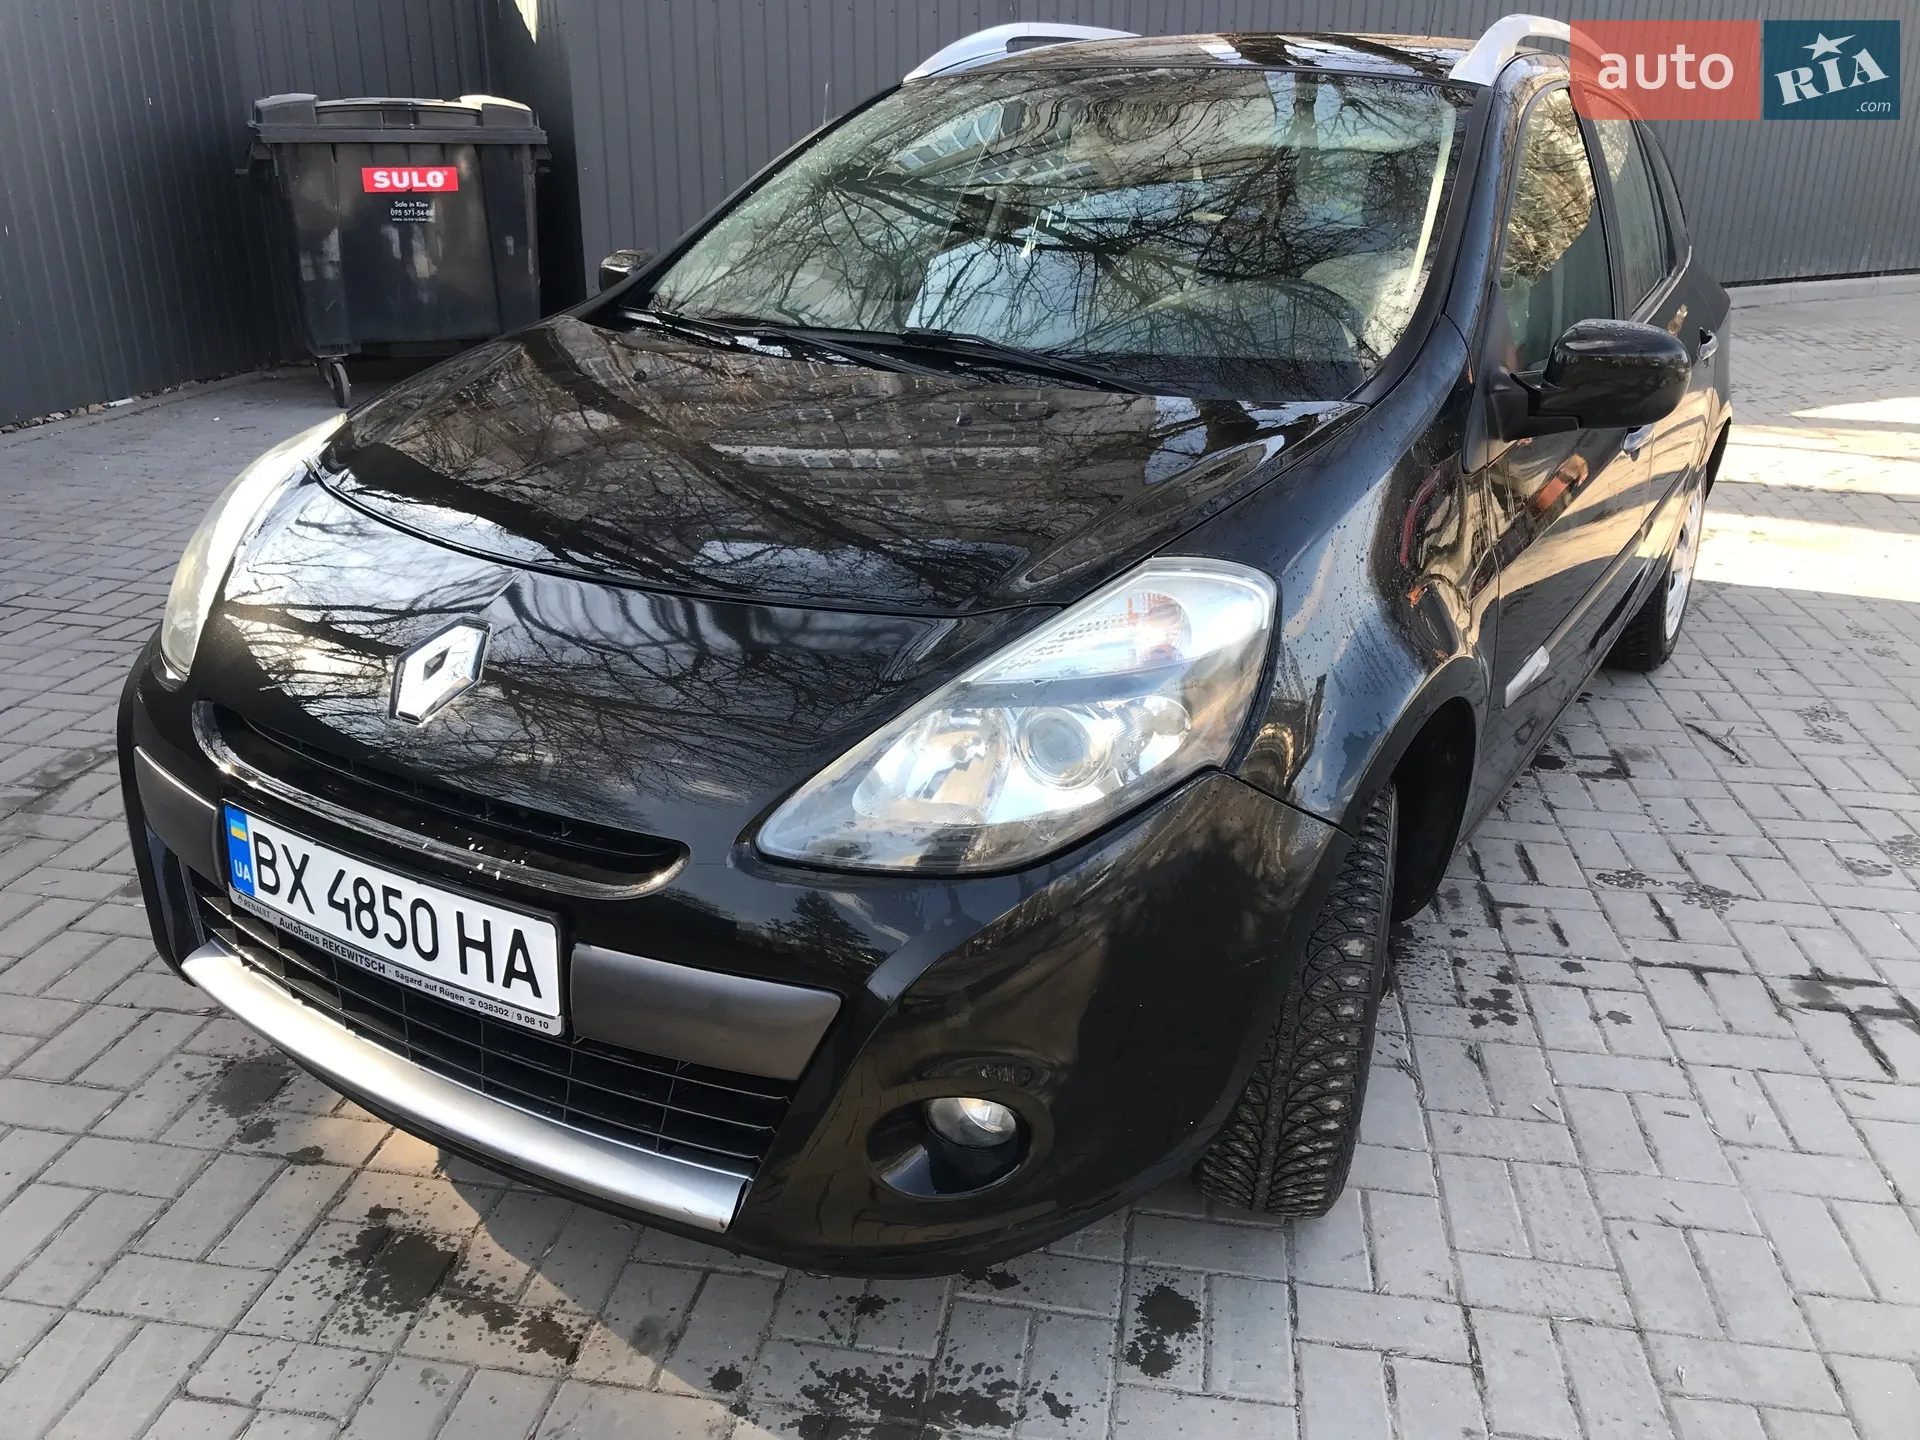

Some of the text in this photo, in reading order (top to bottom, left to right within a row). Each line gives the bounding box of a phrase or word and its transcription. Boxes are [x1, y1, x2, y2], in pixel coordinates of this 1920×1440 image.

[373, 171, 444, 188] SULO
[234, 859, 252, 883] UA
[253, 831, 542, 998] BX 4850 HA
[243, 899, 271, 919] RENAULT
[279, 918, 320, 945] Autohaus
[322, 938, 385, 974] REKEWITSCH
[395, 970, 422, 988] Sagard
[424, 981, 437, 992] auf
[439, 986, 465, 1003] Rügen
[478, 999, 509, 1017] 038302
[516, 1012, 522, 1021] 9
[524, 1015, 535, 1025] 08
[538, 1019, 549, 1030] 10
